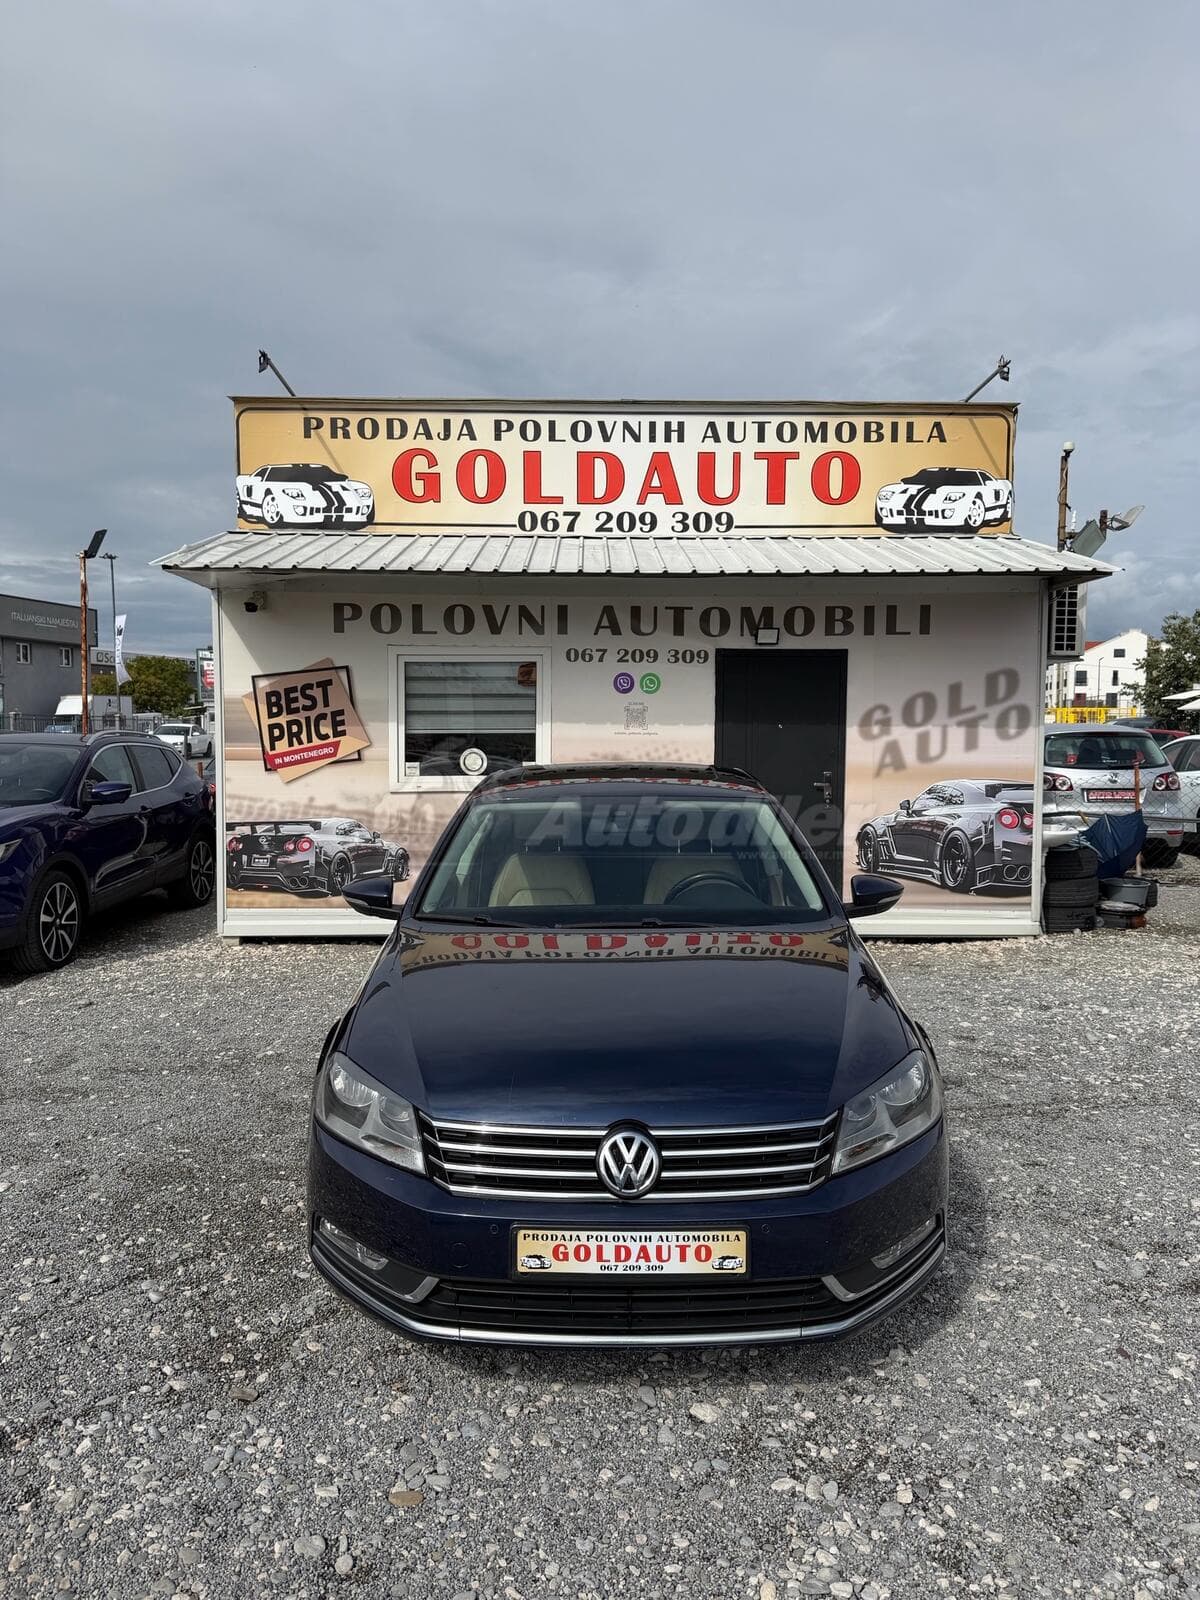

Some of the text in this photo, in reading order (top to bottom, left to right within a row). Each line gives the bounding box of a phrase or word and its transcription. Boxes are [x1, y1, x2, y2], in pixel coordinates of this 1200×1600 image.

[303, 416, 948, 444] PRODAJA POLOVNIH AUTOMOBILA
[391, 447, 862, 507] GOLDAUTO
[517, 510, 735, 533] 067 209 309
[332, 602, 932, 638] POLOVNI AUTOMOBILI
[565, 647, 710, 665] 067 209 309
[265, 678, 333, 720] BEST
[857, 667, 1021, 742] GOLD
[267, 708, 347, 752] PRICE
[873, 703, 1032, 780] AUTO
[274, 746, 334, 766] IN MONTENEGRO
[523, 1232, 741, 1243] PRODAJA POLOVNIH AUTOMOBILA
[552, 1243, 713, 1263] GOLDAUTO
[599, 1264, 664, 1272] 067 209 309
